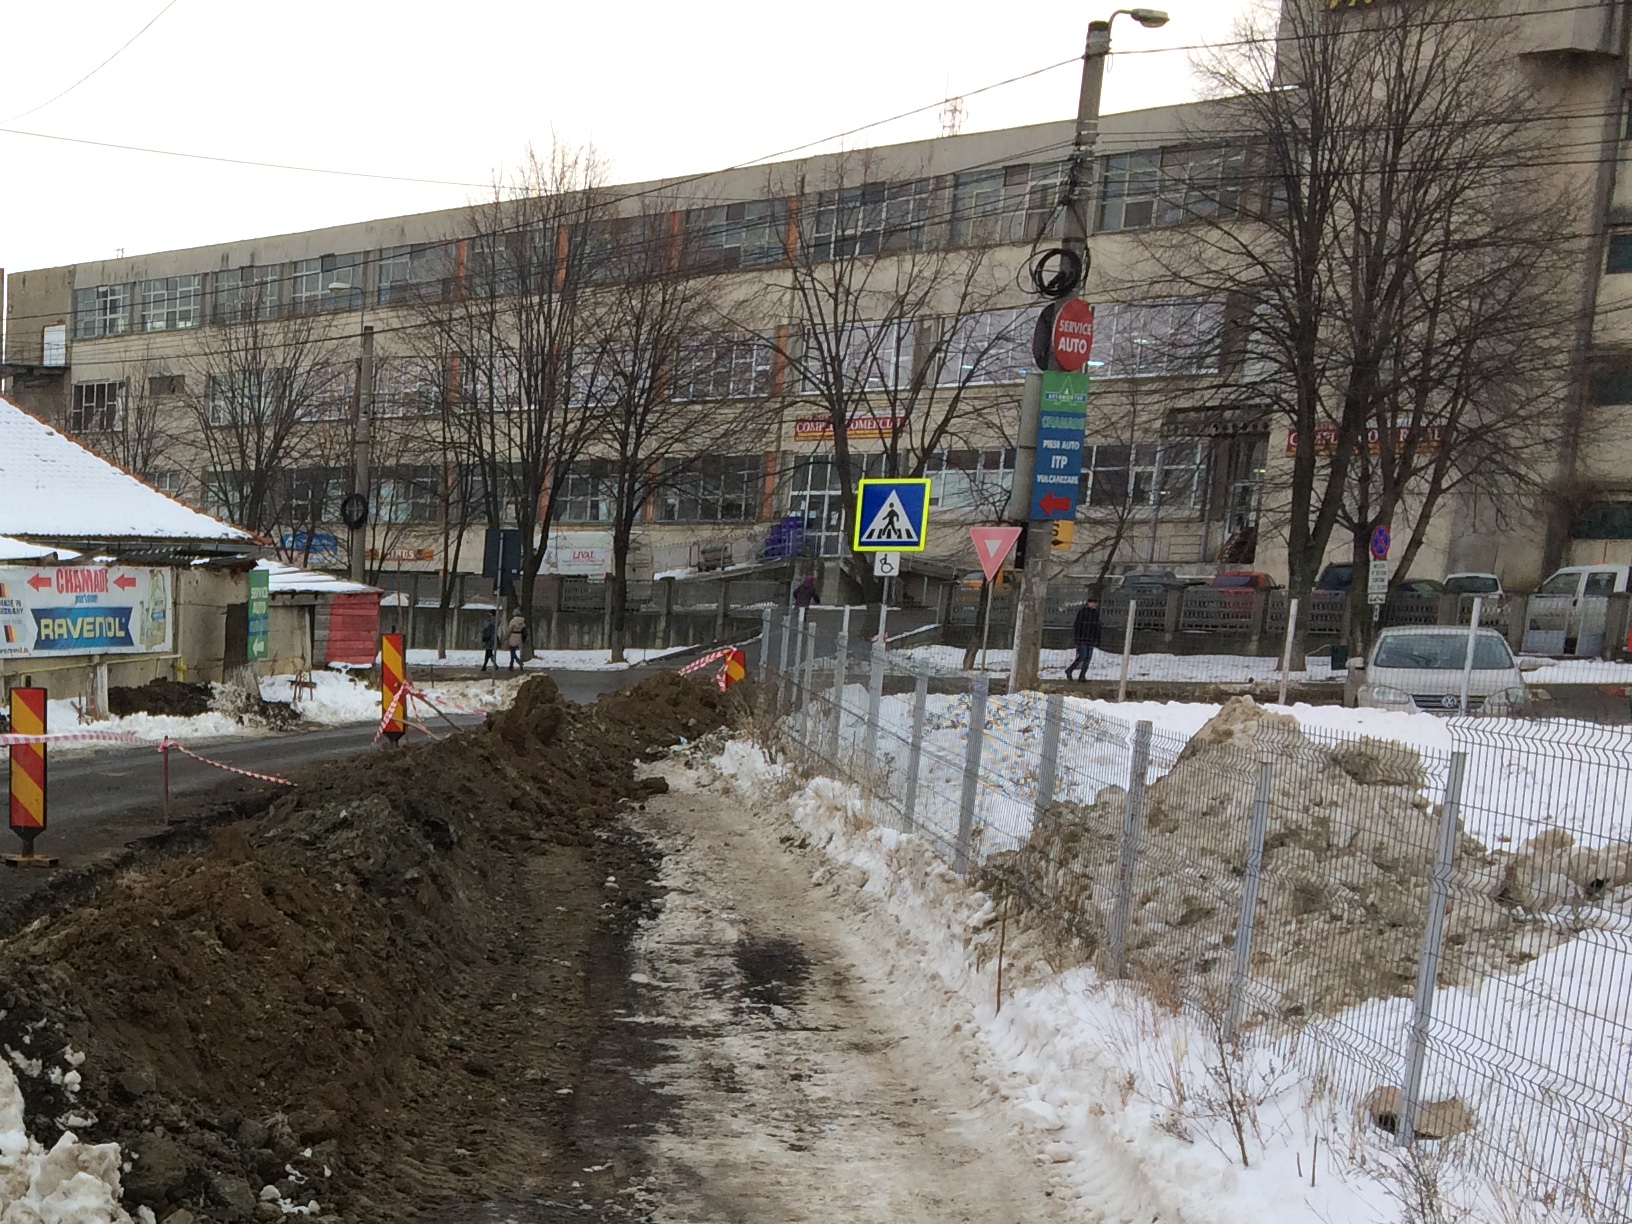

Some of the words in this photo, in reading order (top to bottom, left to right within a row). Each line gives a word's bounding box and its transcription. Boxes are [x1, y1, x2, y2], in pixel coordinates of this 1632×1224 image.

[1059, 320, 1092, 335] SERVICE
[1058, 337, 1087, 354] AUTO
[1062, 441, 1080, 450] AUTO
[1051, 455, 1068, 468] ITP
[56, 568, 109, 594] CHAMADE
[40, 616, 126, 640] RAVENOL
